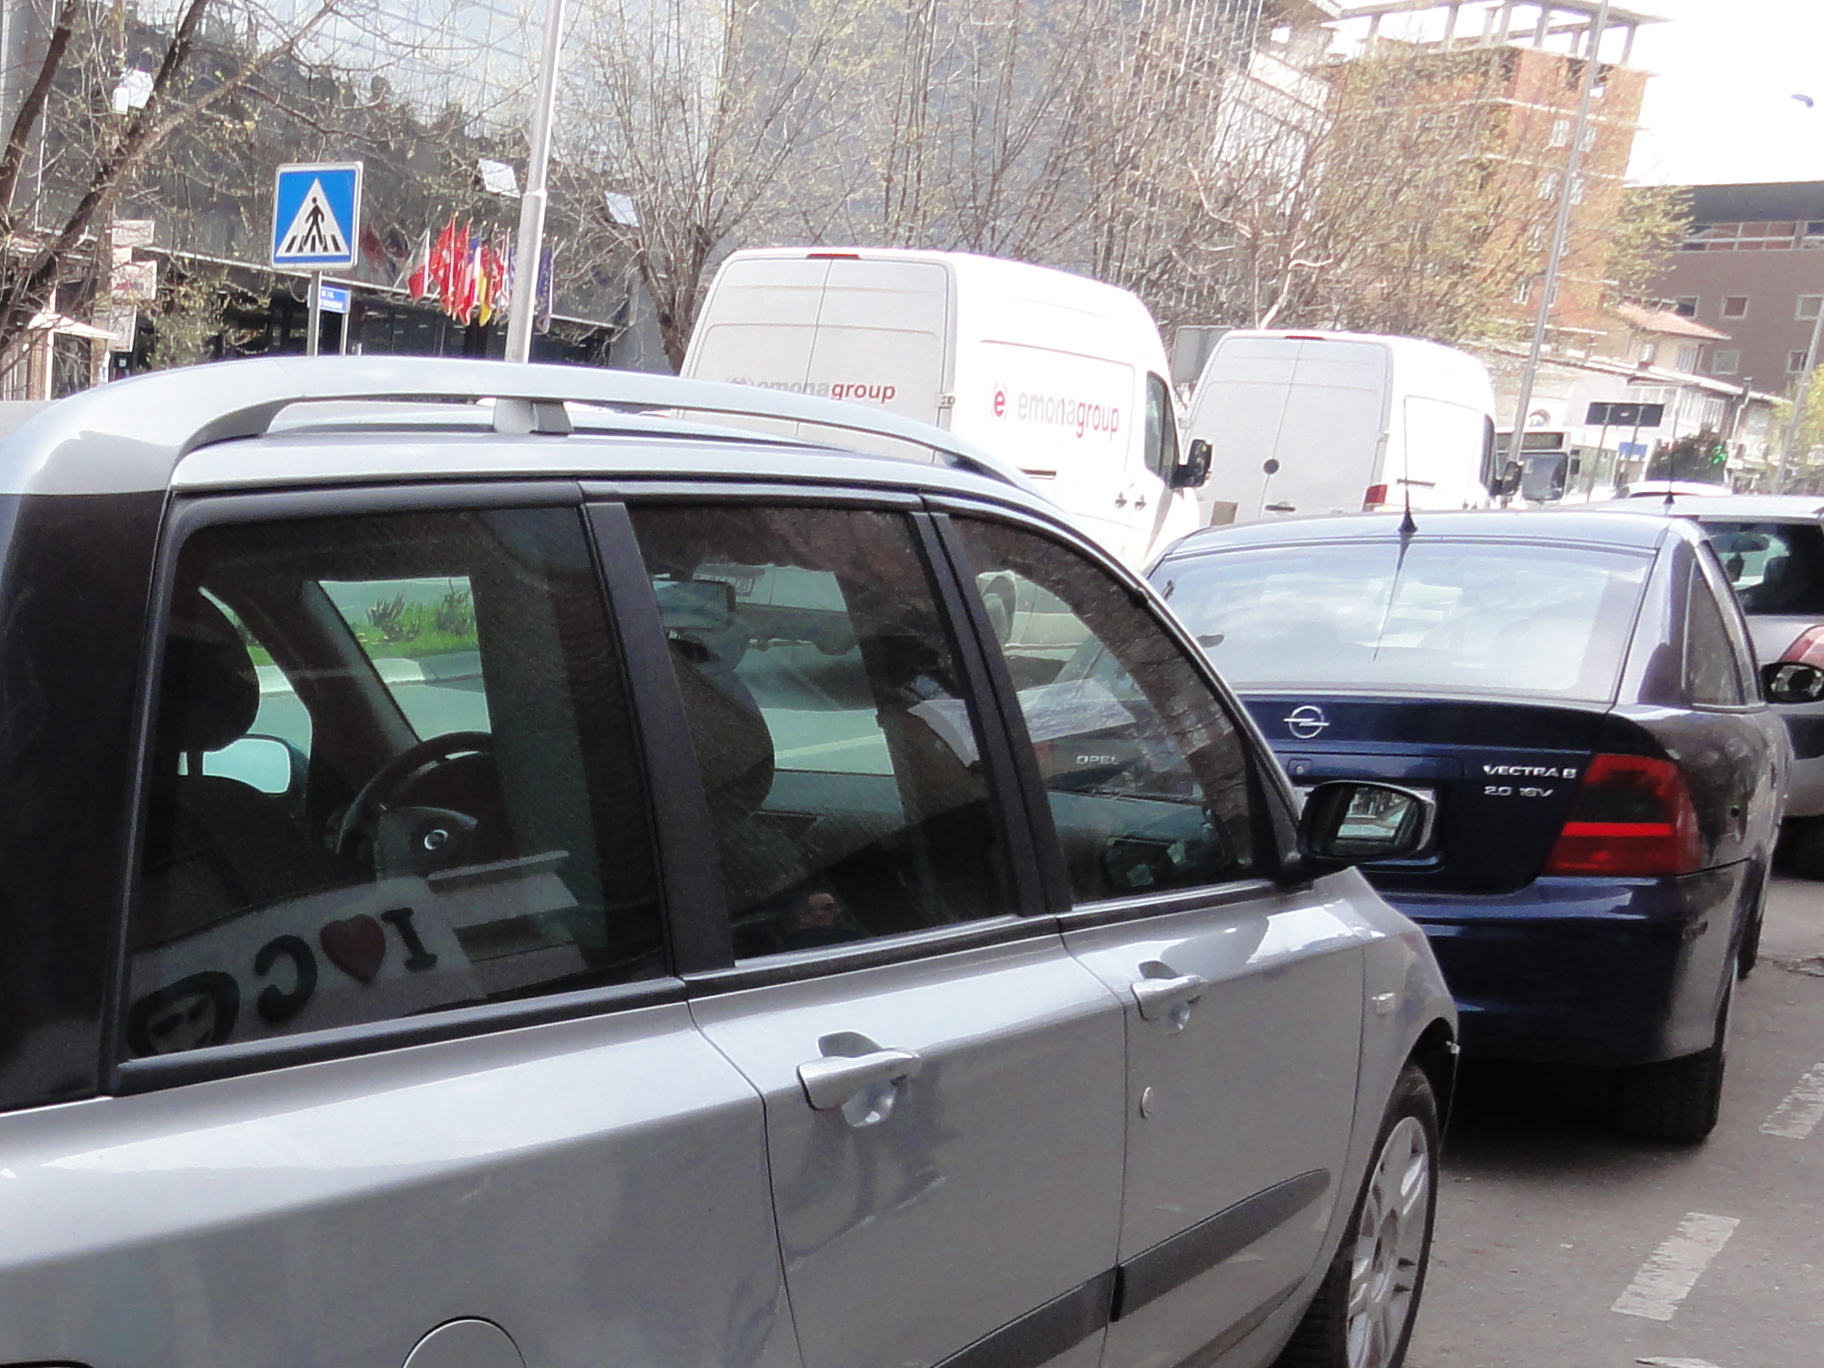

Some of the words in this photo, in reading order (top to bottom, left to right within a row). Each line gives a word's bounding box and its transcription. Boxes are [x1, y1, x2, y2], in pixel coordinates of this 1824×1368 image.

[1017, 391, 1119, 442] emonagroup
[1076, 755, 1119, 765] OPEL
[1483, 765, 1559, 778] VECTRA
